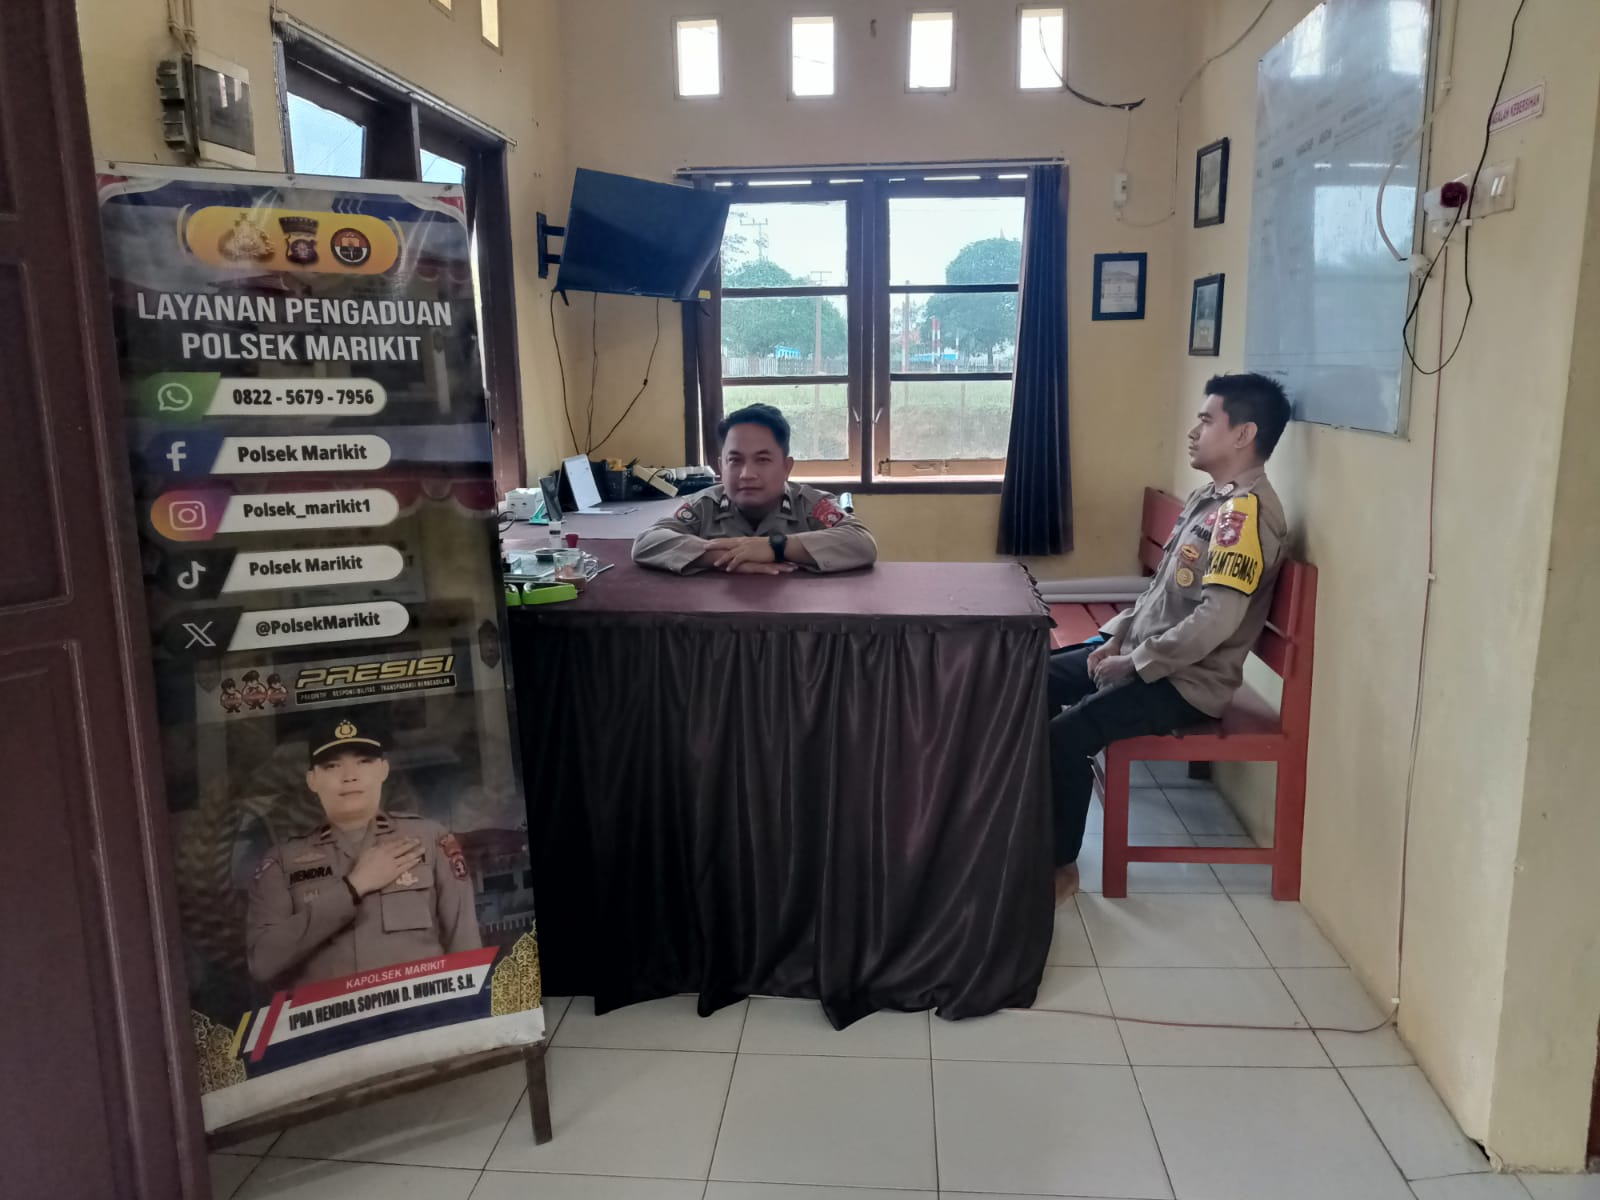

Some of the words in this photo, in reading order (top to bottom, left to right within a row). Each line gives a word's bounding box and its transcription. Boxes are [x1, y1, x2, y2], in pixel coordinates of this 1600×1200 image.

[137, 293, 277, 322] LAYANAN
[286, 298, 452, 327] PENGADUAN
[182, 332, 298, 360] POLSEK
[306, 335, 421, 361] MARIKIT
[233, 389, 272, 405] 0822
[285, 389, 324, 405] 5679
[336, 389, 374, 405] 7956
[238, 445, 298, 462] Polsek
[301, 444, 367, 461] Marikit
[243, 499, 371, 519] Polsek_marikit1
[249, 559, 302, 576] Polsek
[305, 556, 363, 572] Marikit
[256, 612, 380, 637] @PolsekMarikit
[295, 655, 454, 688] PRESISI
[289, 865, 333, 885] HENDRA
[346, 969, 402, 989] KAPOLSEK
[404, 959, 447, 976] MARIKIT
[289, 1013, 314, 1031] IPDA
[315, 1001, 357, 1024] HENDRA
[358, 989, 400, 1013] SOPIYAN
[413, 977, 456, 999] MUNTHE,
[457, 973, 476, 990] S.H.
